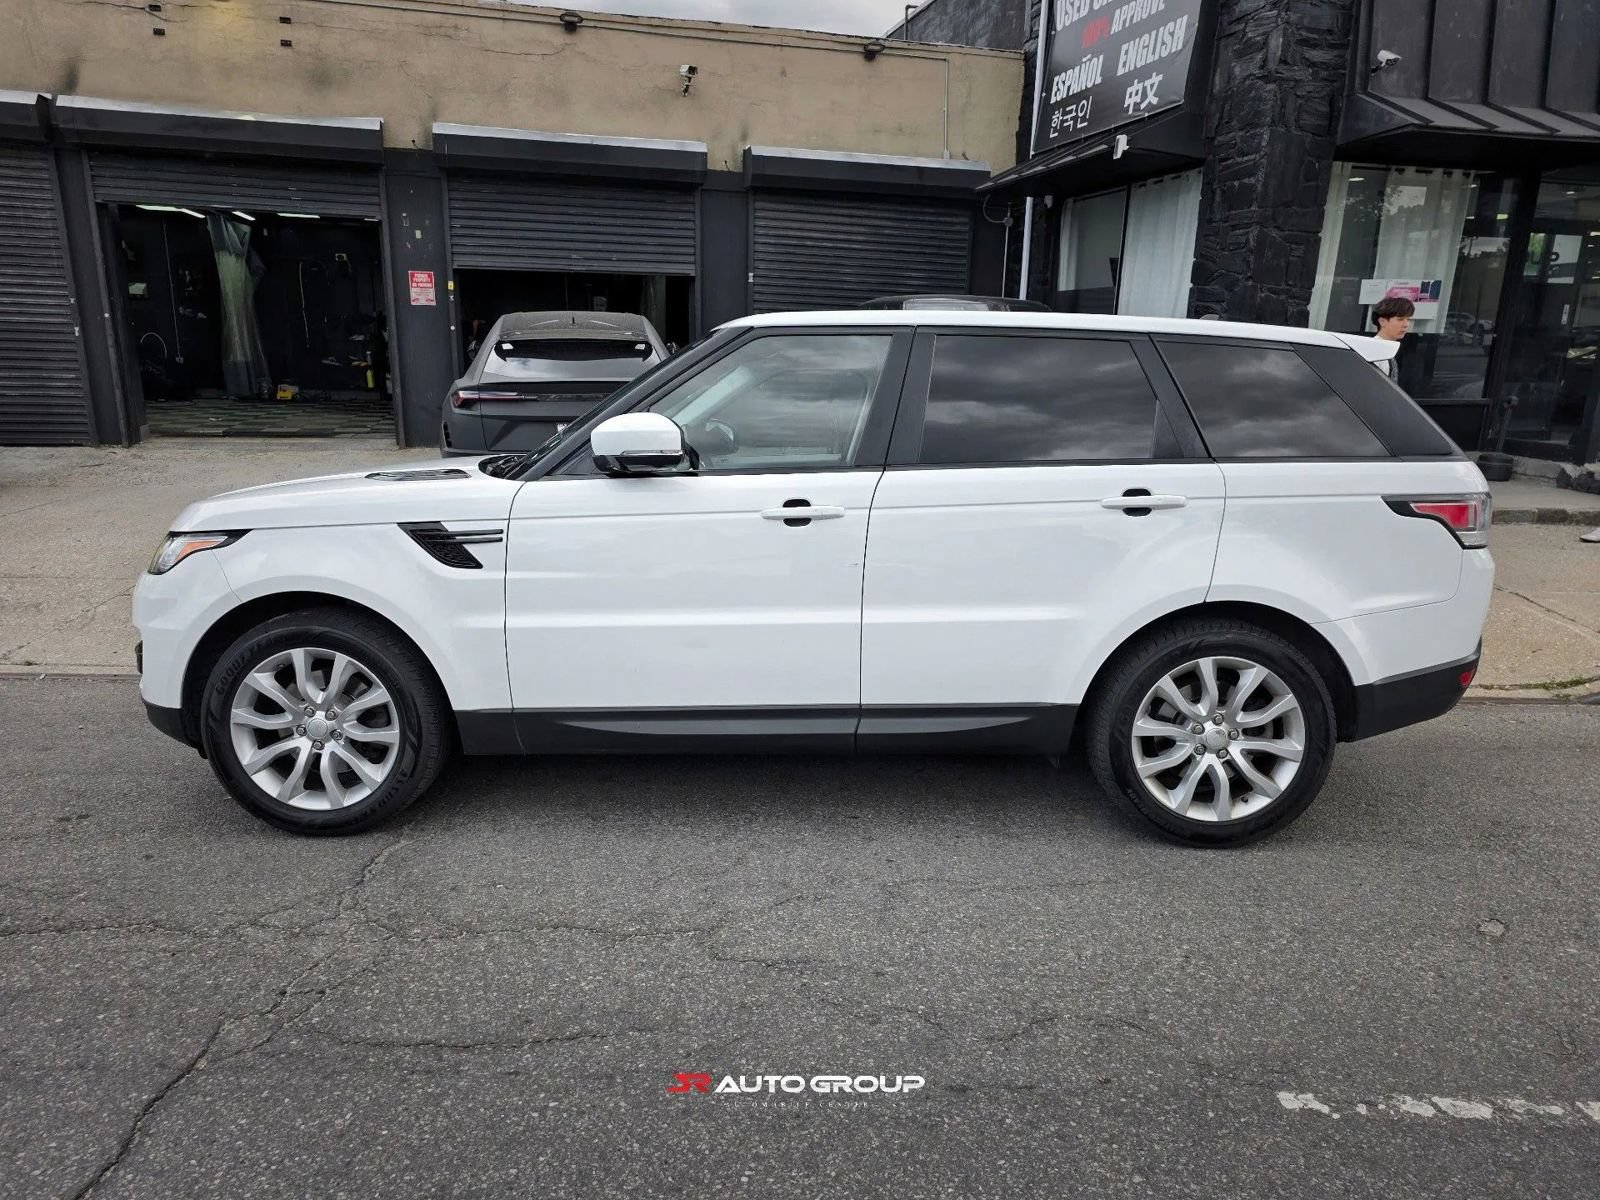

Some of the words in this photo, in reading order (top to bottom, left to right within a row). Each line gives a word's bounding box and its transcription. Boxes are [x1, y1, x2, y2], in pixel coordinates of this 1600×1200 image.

[1056, 0, 1091, 31] USED
[1116, 15, 1189, 76] ENGLISH
[1050, 54, 1103, 104] ESPAÑOL
[1124, 72, 1163, 115] 中文
[1050, 96, 1092, 138] 한국인
